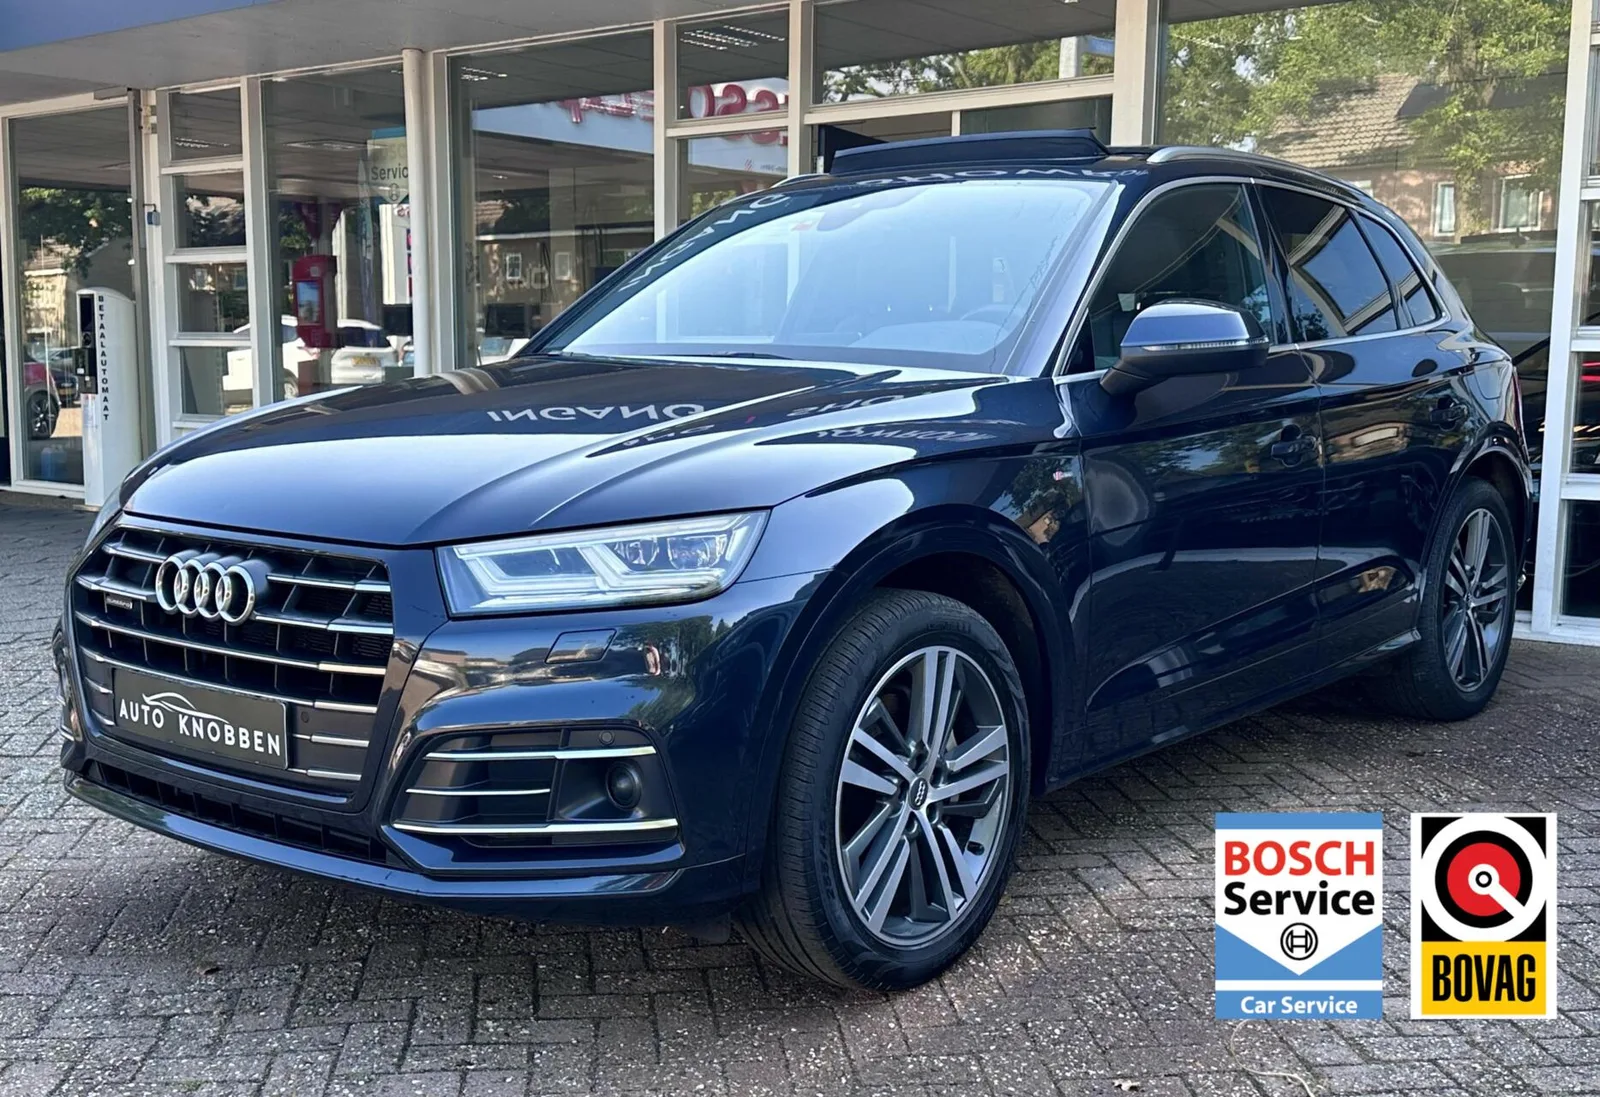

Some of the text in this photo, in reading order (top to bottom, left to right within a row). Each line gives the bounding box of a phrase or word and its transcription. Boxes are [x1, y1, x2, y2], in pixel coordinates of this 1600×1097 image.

[371, 163, 409, 181] Servic
[98, 295, 109, 421] BETAALAUTOMAAT
[119, 698, 281, 757] AUTO KNOBBEN
